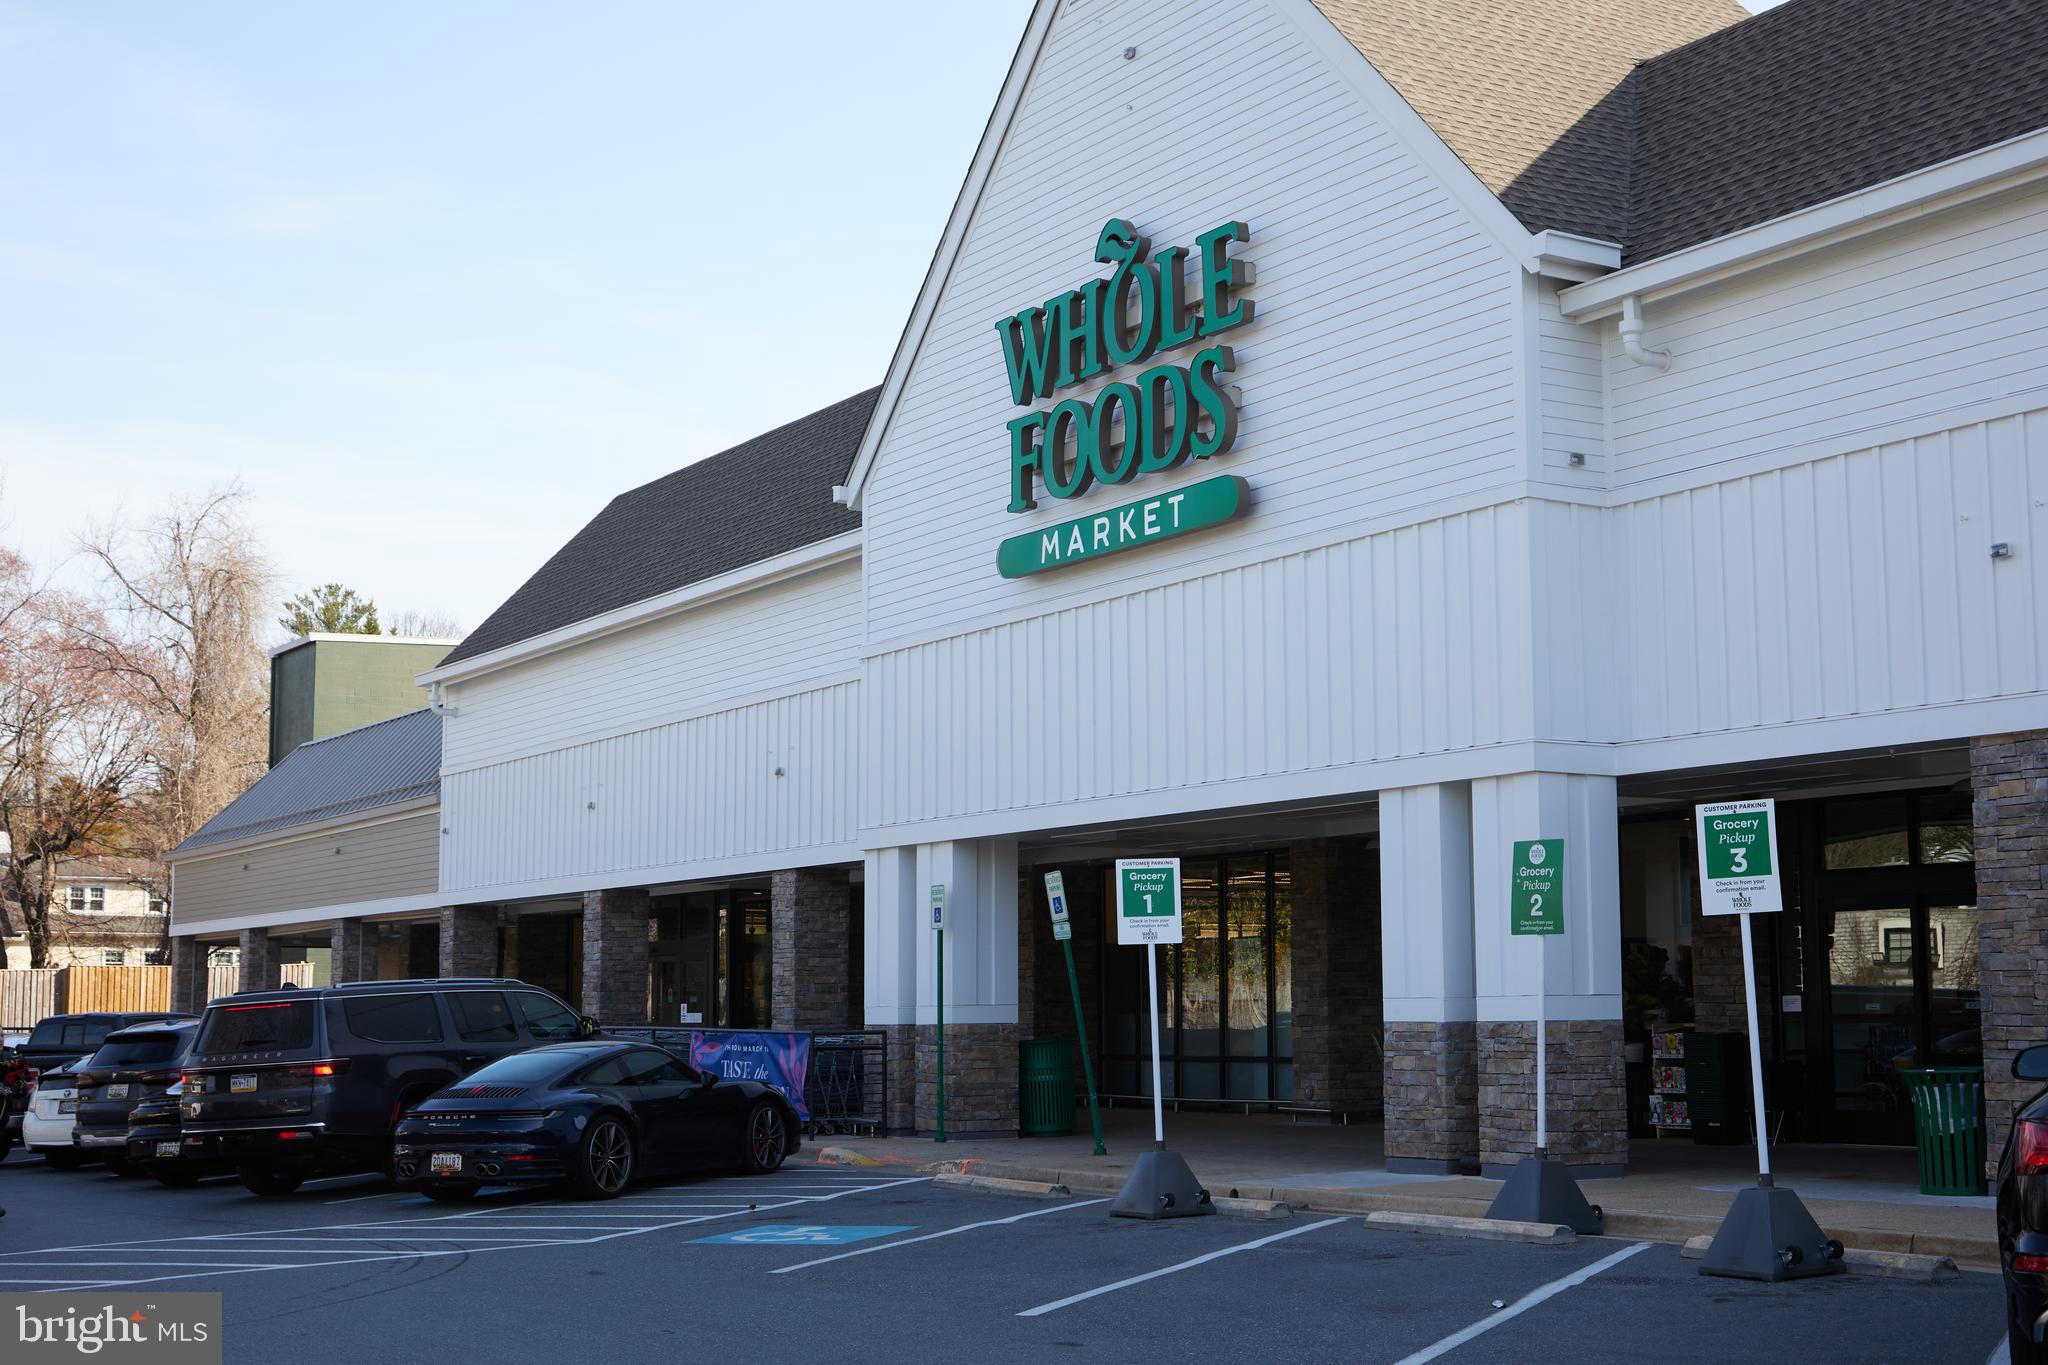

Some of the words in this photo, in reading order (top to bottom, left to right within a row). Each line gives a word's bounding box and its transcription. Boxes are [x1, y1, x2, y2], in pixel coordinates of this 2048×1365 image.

[995, 218, 1252, 405] WHOLE
[1007, 345, 1238, 513] FOODS
[1041, 494, 1185, 563] MARKET
[1703, 804, 1738, 812] CUSTOMER
[1713, 819, 1759, 830] Grocery
[1719, 832, 1755, 844] Pickup
[1730, 847, 1748, 873] 3
[1129, 872, 1167, 881] Grocery
[1520, 867, 1555, 877] Grocery
[1133, 882, 1164, 893] Pickup
[1523, 879, 1551, 892] Pickup
[1143, 894, 1153, 914] 1
[1530, 894, 1543, 916] 2
[721, 1060, 752, 1079] TASTE
[754, 1063, 769, 1080] the
